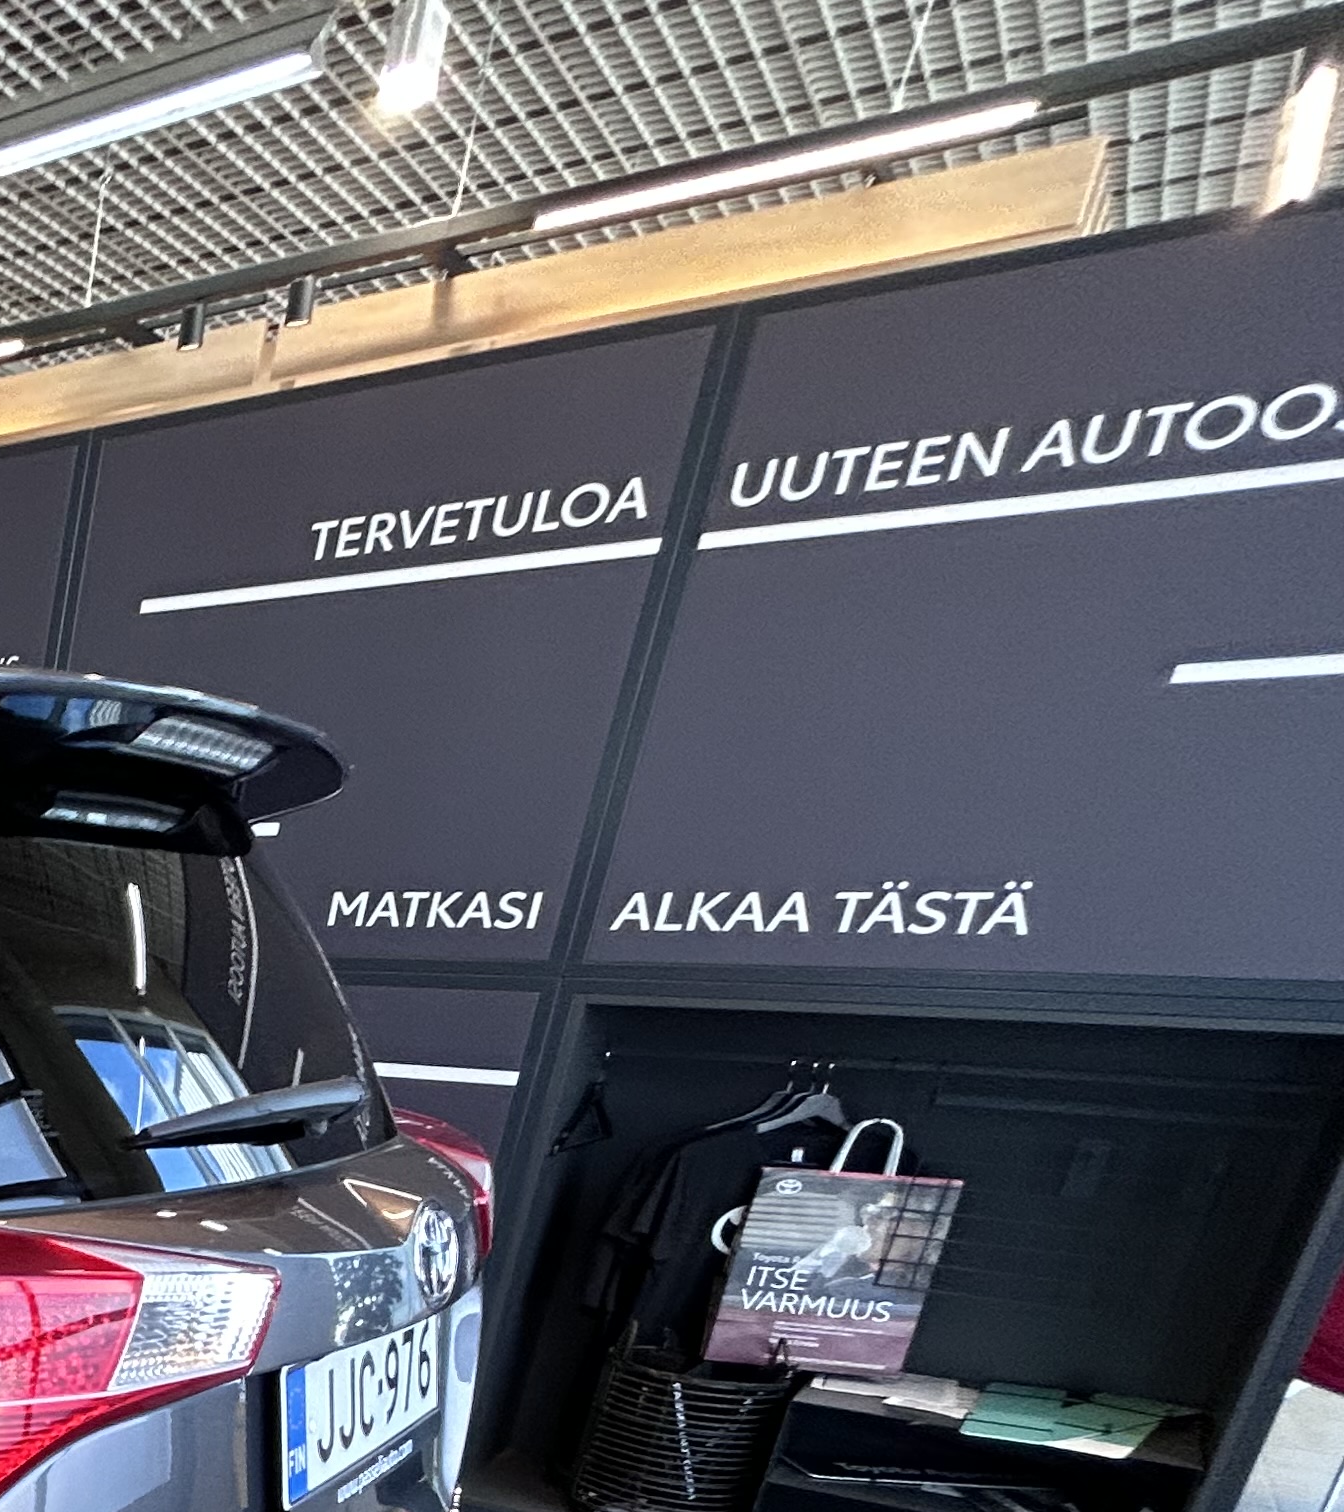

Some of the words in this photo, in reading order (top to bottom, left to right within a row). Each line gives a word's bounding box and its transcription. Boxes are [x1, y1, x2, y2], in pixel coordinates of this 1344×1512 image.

[311, 476, 648, 561] TERVETULOA
[730, 427, 1011, 508] UUTEEN
[1019, 383, 1344, 473] AUTOO
[326, 891, 544, 930] MATKASI
[609, 891, 810, 933] ALKAA
[835, 880, 1034, 936] TÄSTÄ
[745, 1265, 810, 1291] ITSE
[740, 1287, 894, 1323] VARMUUS
[316, 1320, 432, 1464] JJC-976
[288, 1443, 307, 1478] FIN
